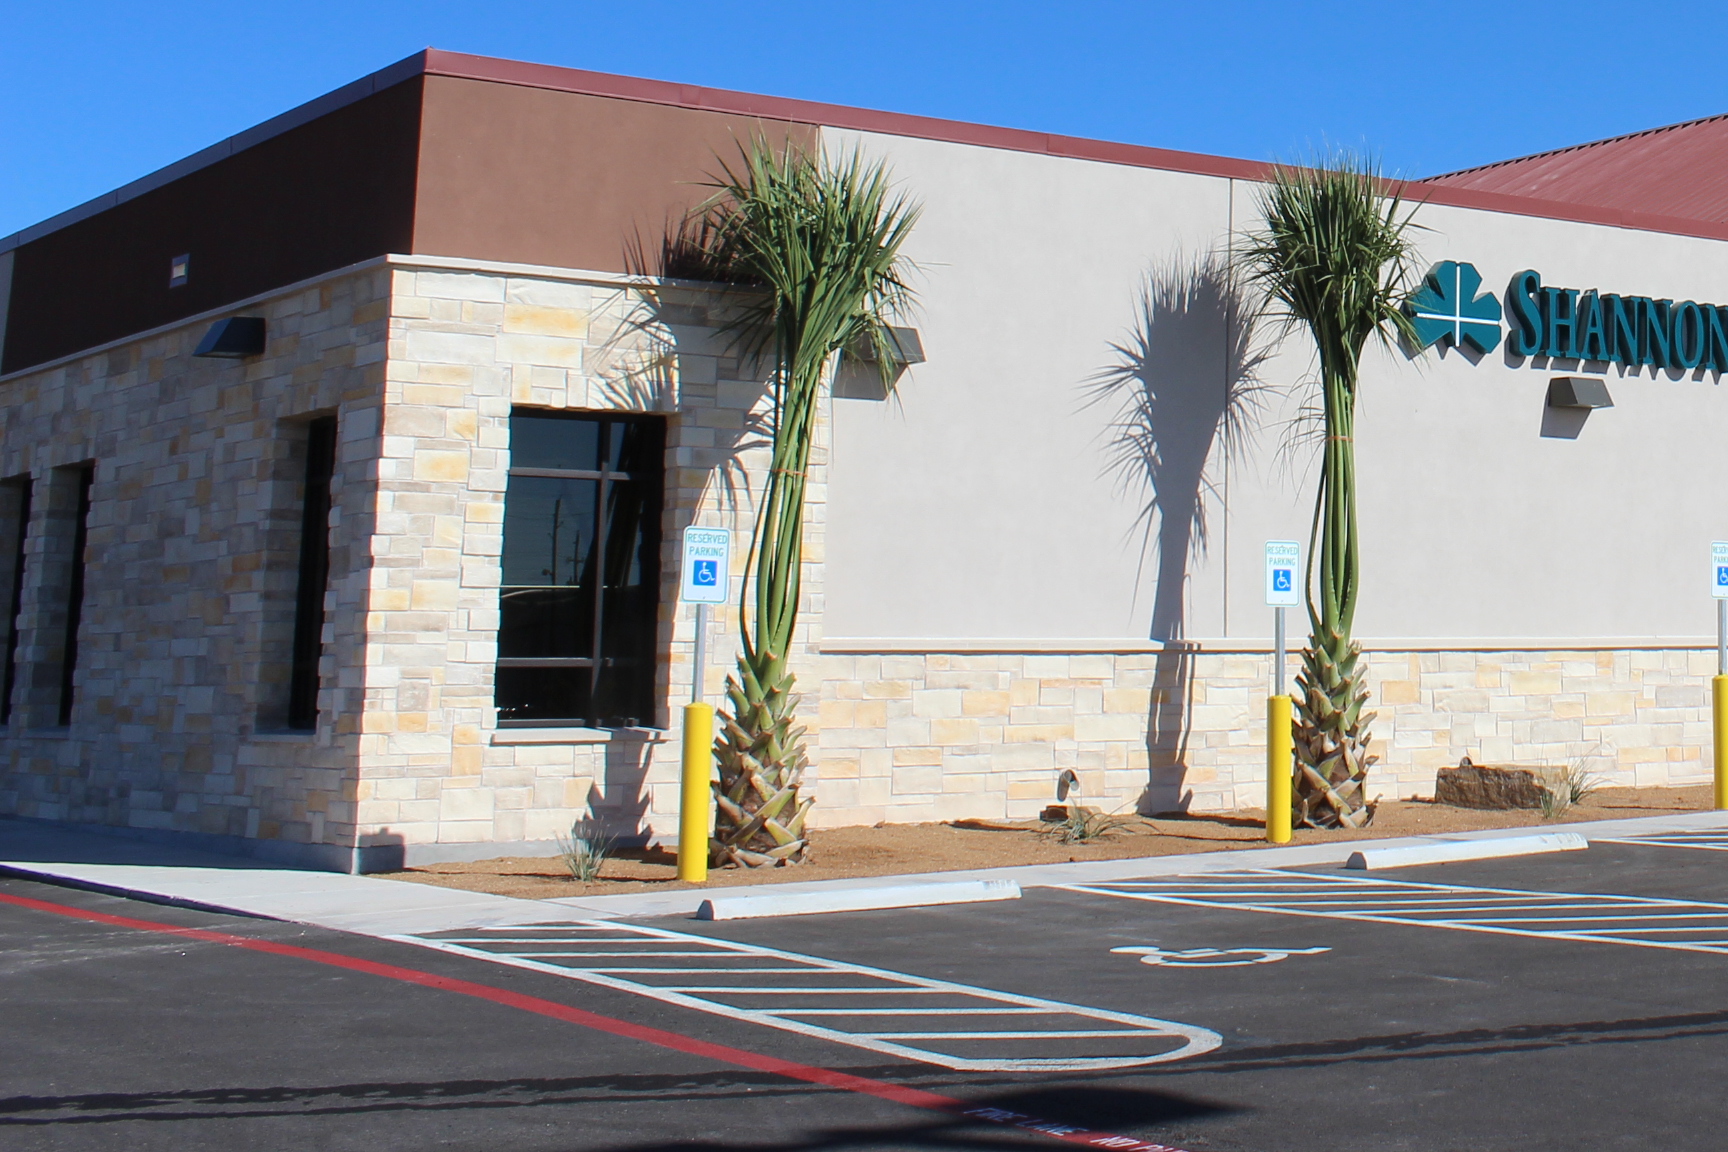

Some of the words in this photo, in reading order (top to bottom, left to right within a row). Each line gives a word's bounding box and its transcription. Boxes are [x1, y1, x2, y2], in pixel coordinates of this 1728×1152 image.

[687, 533, 728, 545] RESERVED
[689, 546, 724, 557] PARKING
[1267, 546, 1298, 556] RESERVED
[1269, 557, 1296, 566] PARKING
